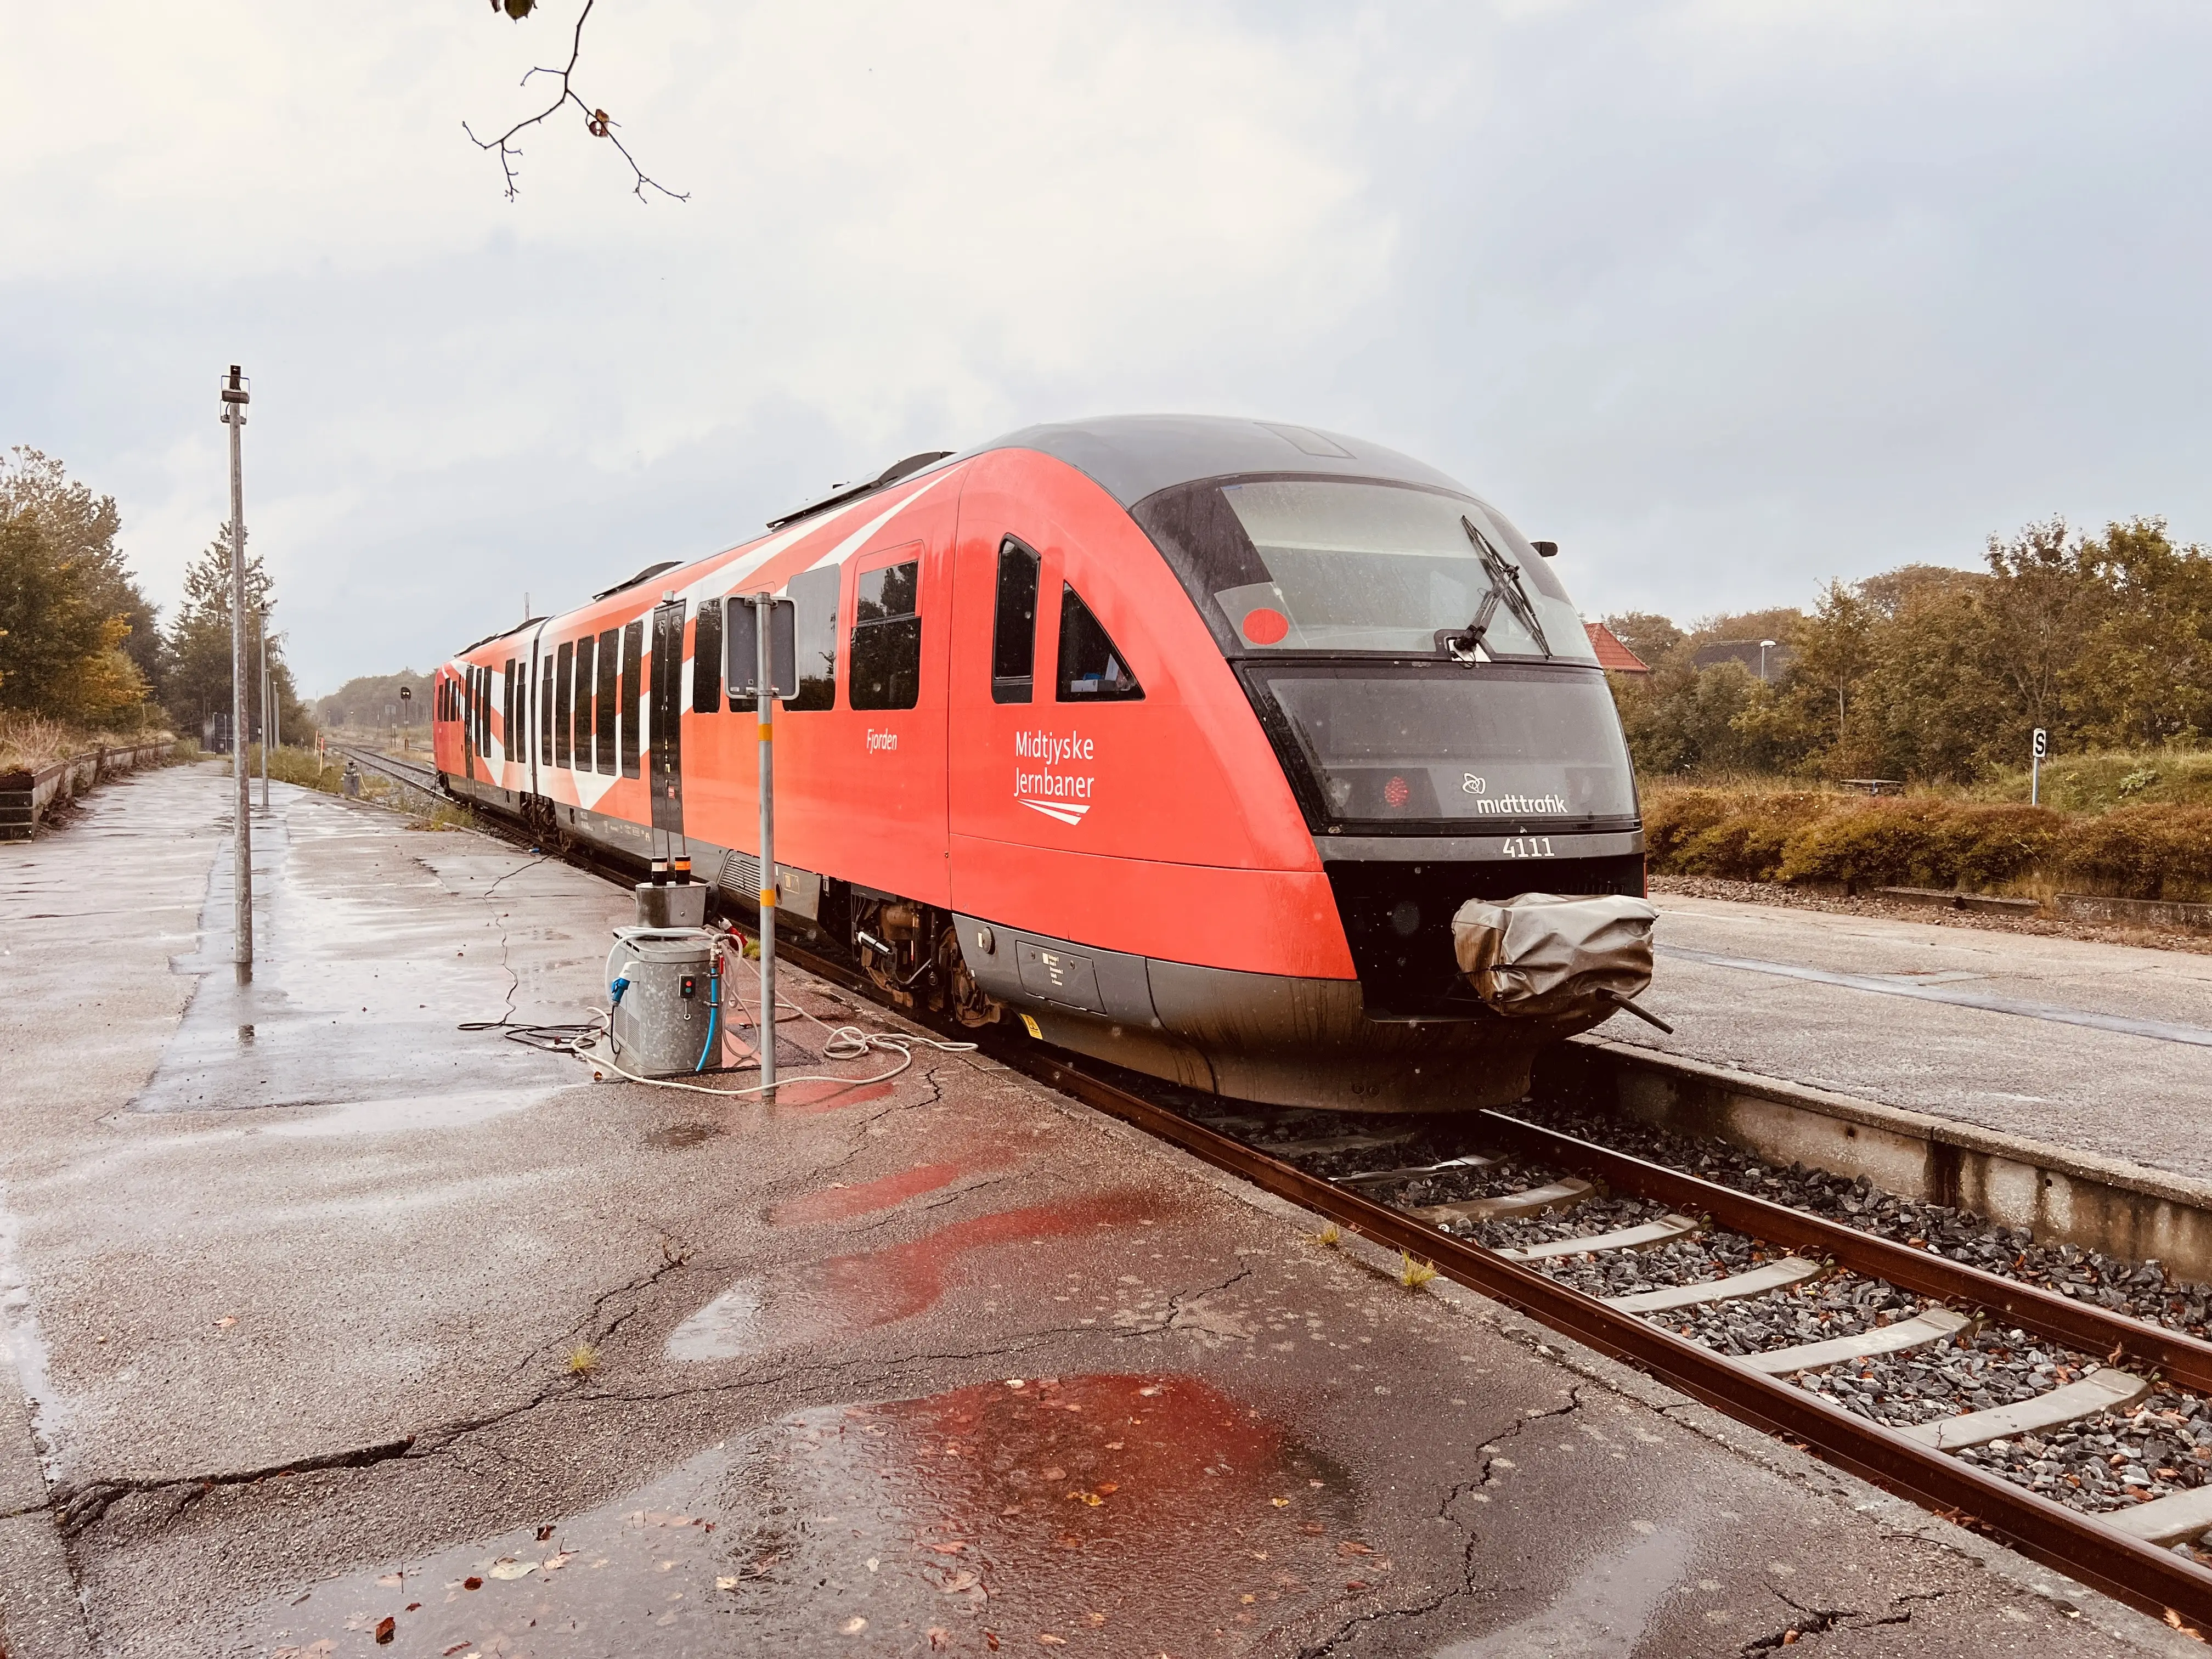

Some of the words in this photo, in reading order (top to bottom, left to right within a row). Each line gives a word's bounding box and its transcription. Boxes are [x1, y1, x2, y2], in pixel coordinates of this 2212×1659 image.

[867, 729, 896, 754] Fjorden
[1015, 730, 1093, 764] Midtjyske
[2035, 733, 2045, 754] S
[1014, 768, 1094, 797] Jernbaner
[1476, 794, 1567, 814] midttrafik
[1503, 837, 1555, 857] 4111
